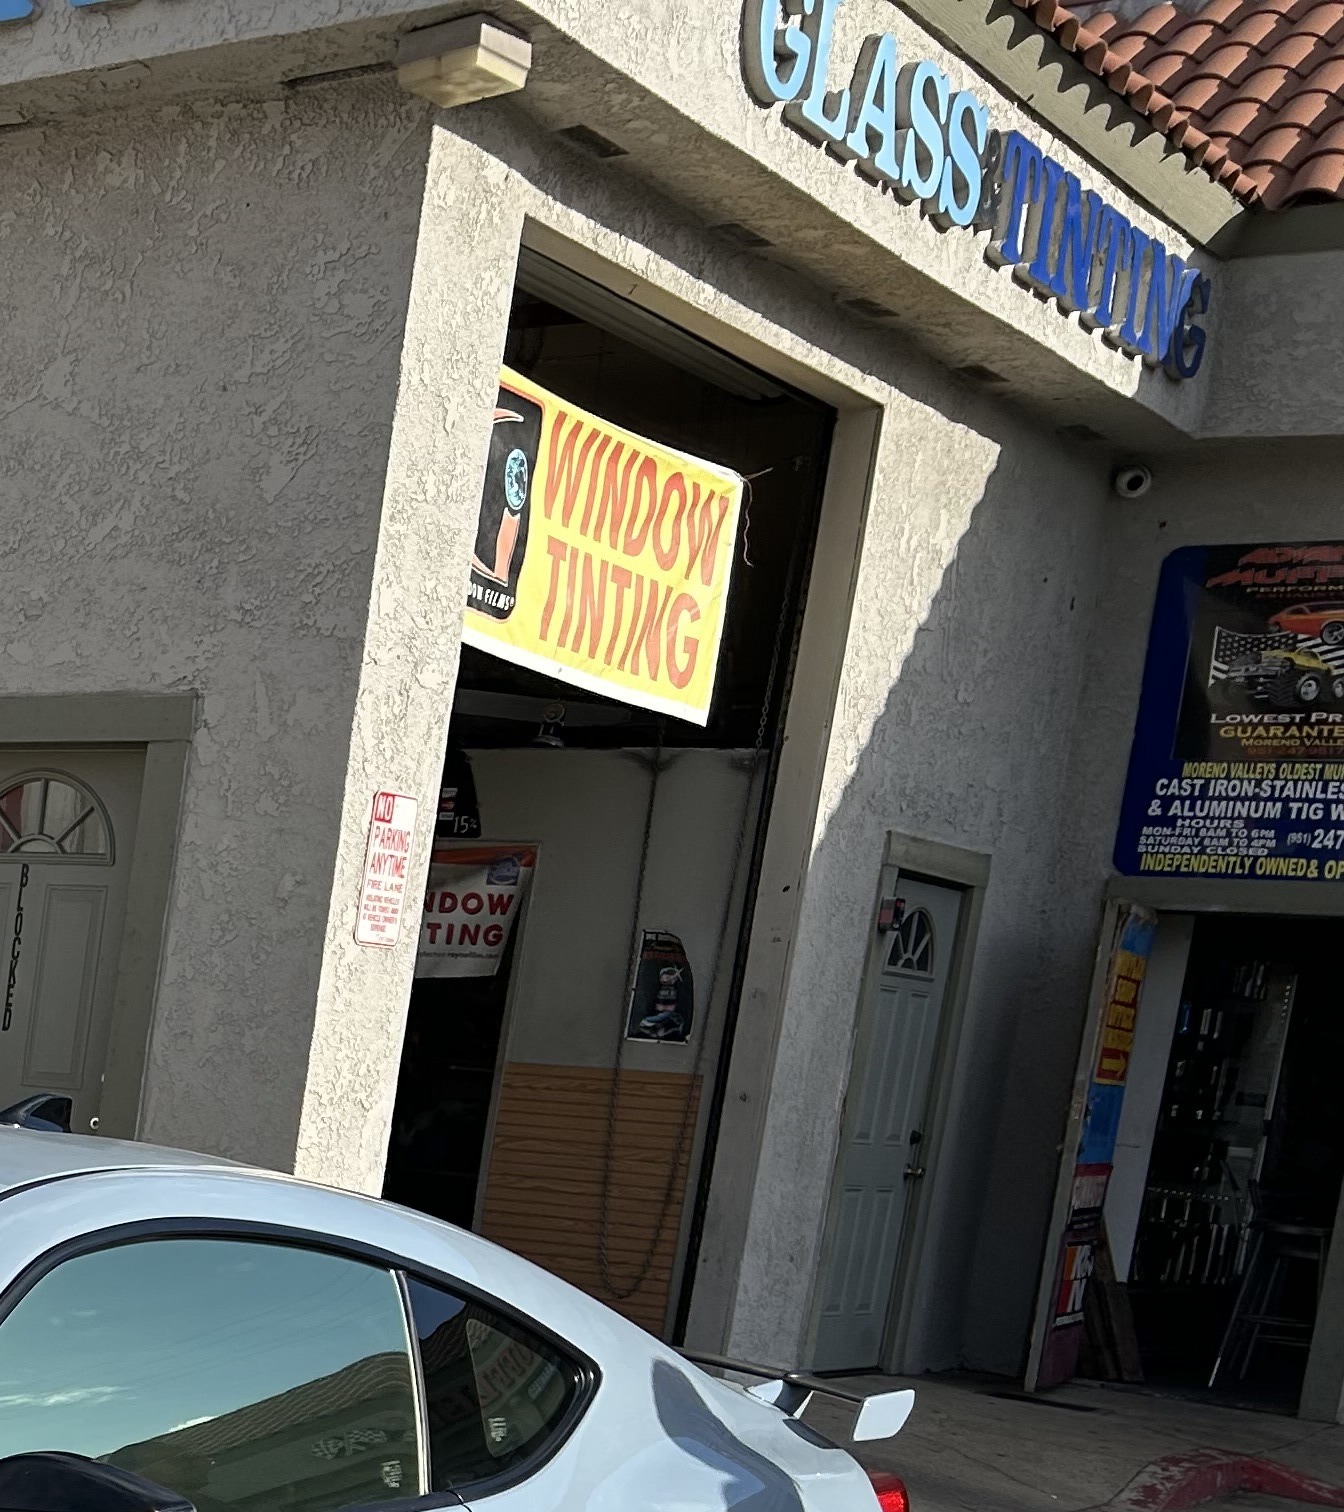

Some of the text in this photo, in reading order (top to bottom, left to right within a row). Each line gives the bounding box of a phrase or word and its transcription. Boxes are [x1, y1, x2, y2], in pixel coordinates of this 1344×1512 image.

[758, 0, 990, 228] GLASS
[1000, 130, 1210, 378] TINTING
[543, 410, 730, 586] WINDOW
[539, 535, 701, 690] TINTING
[1210, 713, 1306, 724] LOWEST
[1241, 738, 1301, 747] MORENO
[1182, 761, 1228, 779] MORENO
[1229, 762, 1275, 780] VALLEYS
[1279, 763, 1321, 780] OLDEST
[1155, 778, 1205, 797] CAST
[376, 795, 394, 822] NO
[1147, 799, 1162, 817] &
[1167, 800, 1283, 820] ALUMINUM
[1288, 803, 1325, 820] TIG
[1142, 826, 1196, 836] MON-FRI
[1231, 828, 1248, 837] TO
[1176, 818, 1245, 828] HOURS
[372, 825, 411, 853] PARKING
[1138, 836, 1201, 845] SATURDAY
[1232, 838, 1249, 847] TO
[1137, 845, 1269, 856] SUNDAY CLOSED
[368, 852, 407, 878] ANYTIME
[1140, 853, 1254, 875] INDEPENDENTLY
[367, 879, 404, 893] FIRE LANE
[427, 923, 504, 947] TING
[1, 863, 30, 1032] BLOCKED
